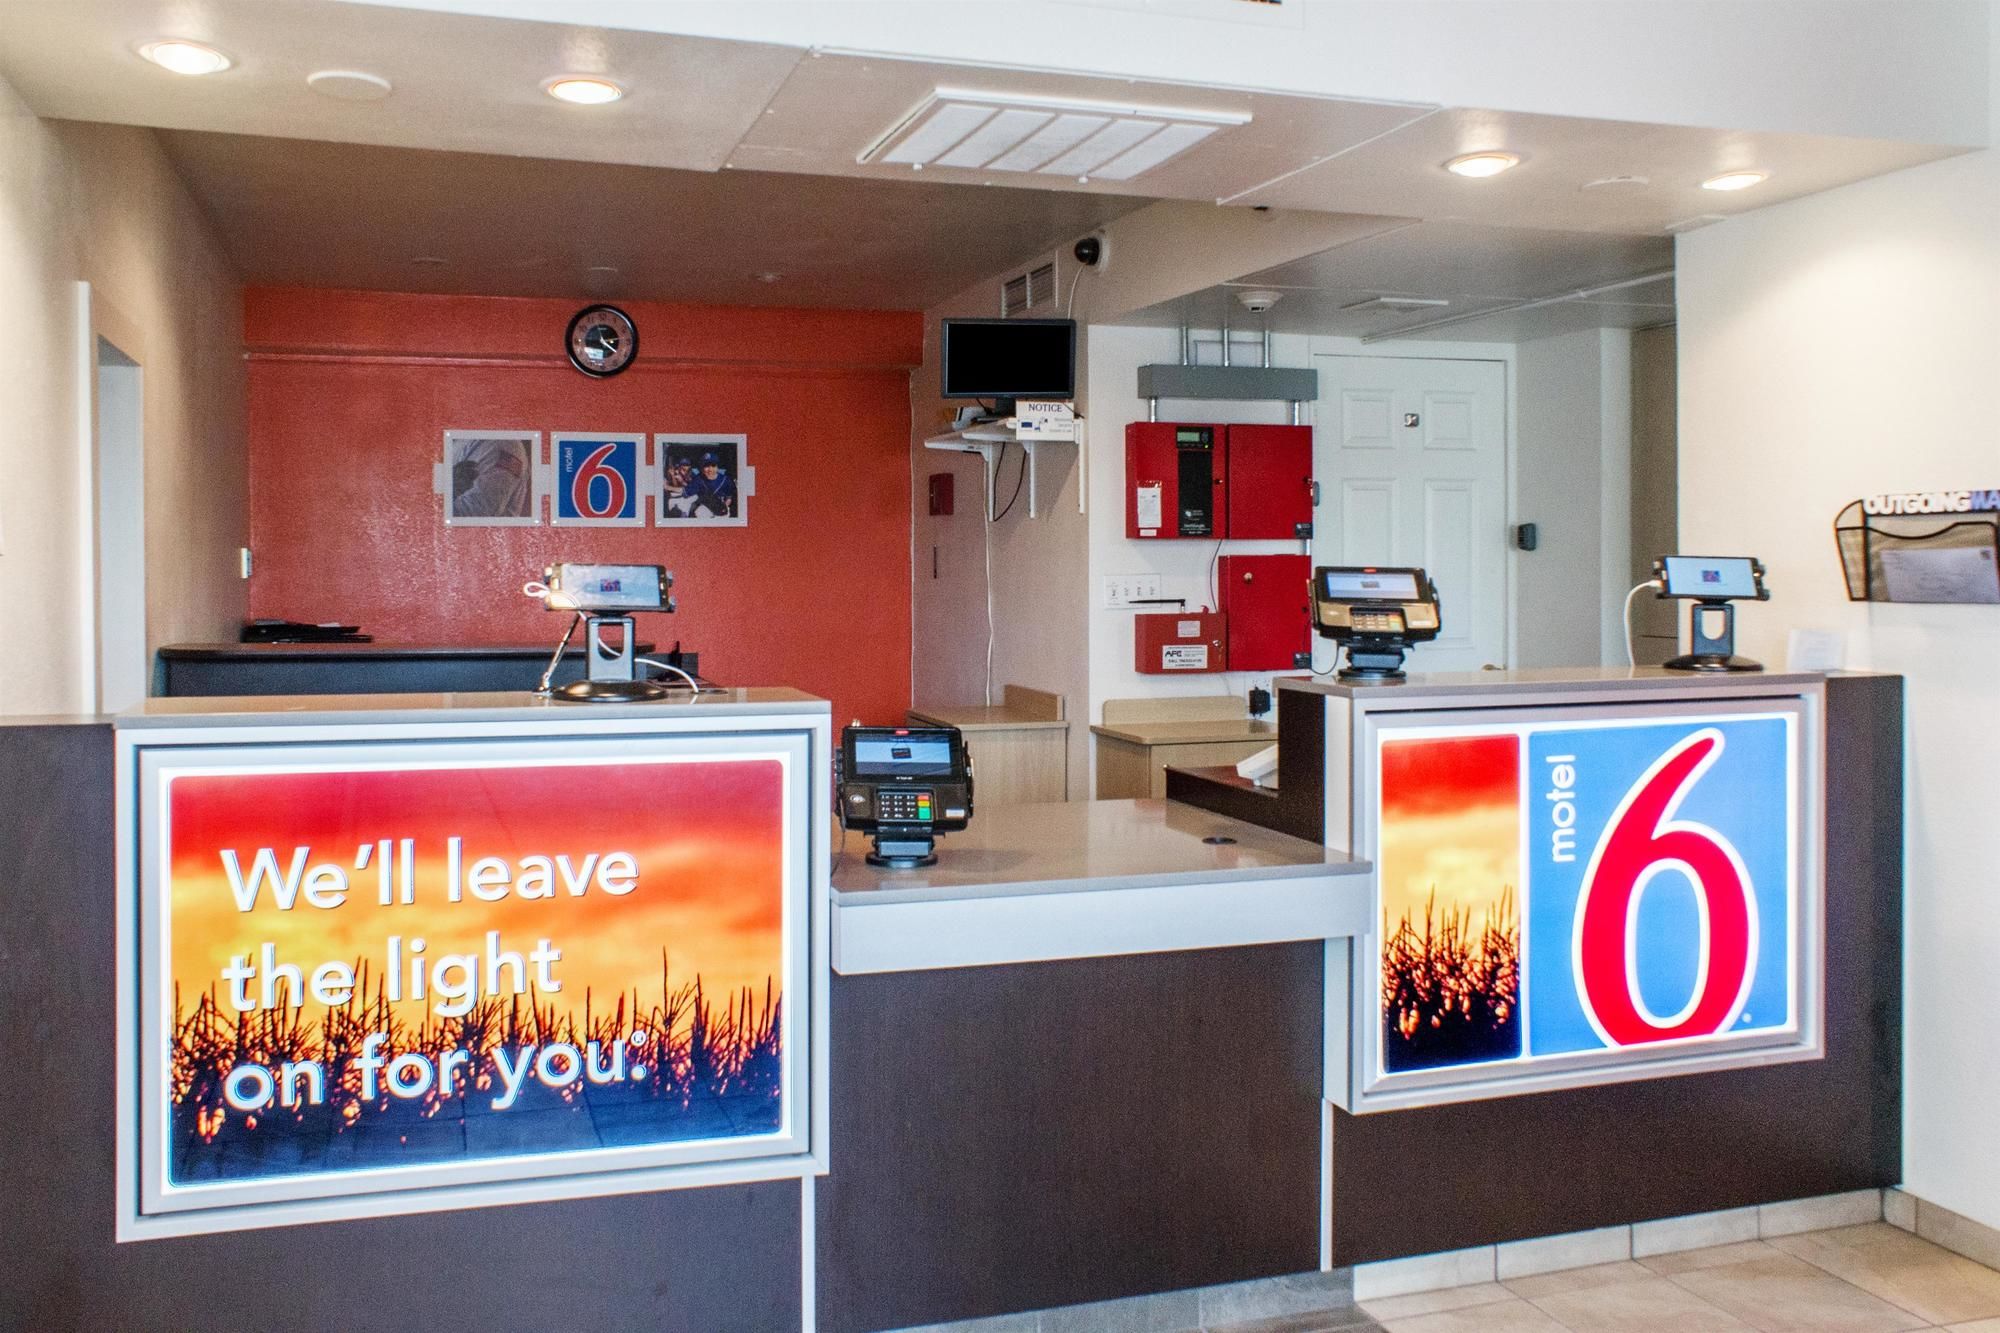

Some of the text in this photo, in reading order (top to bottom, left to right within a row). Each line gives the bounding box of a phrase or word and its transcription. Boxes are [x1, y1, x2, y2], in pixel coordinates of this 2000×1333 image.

[1028, 403, 1063, 412] NOTICE
[565, 443, 627, 519] motel 6
[1863, 491, 1970, 515] OUTGOING
[220, 836, 640, 913] We'll leave
[1546, 727, 1759, 1048] motel 6
[221, 931, 562, 1018] the light
[223, 1058, 325, 1112] on
[356, 1032, 470, 1102] for
